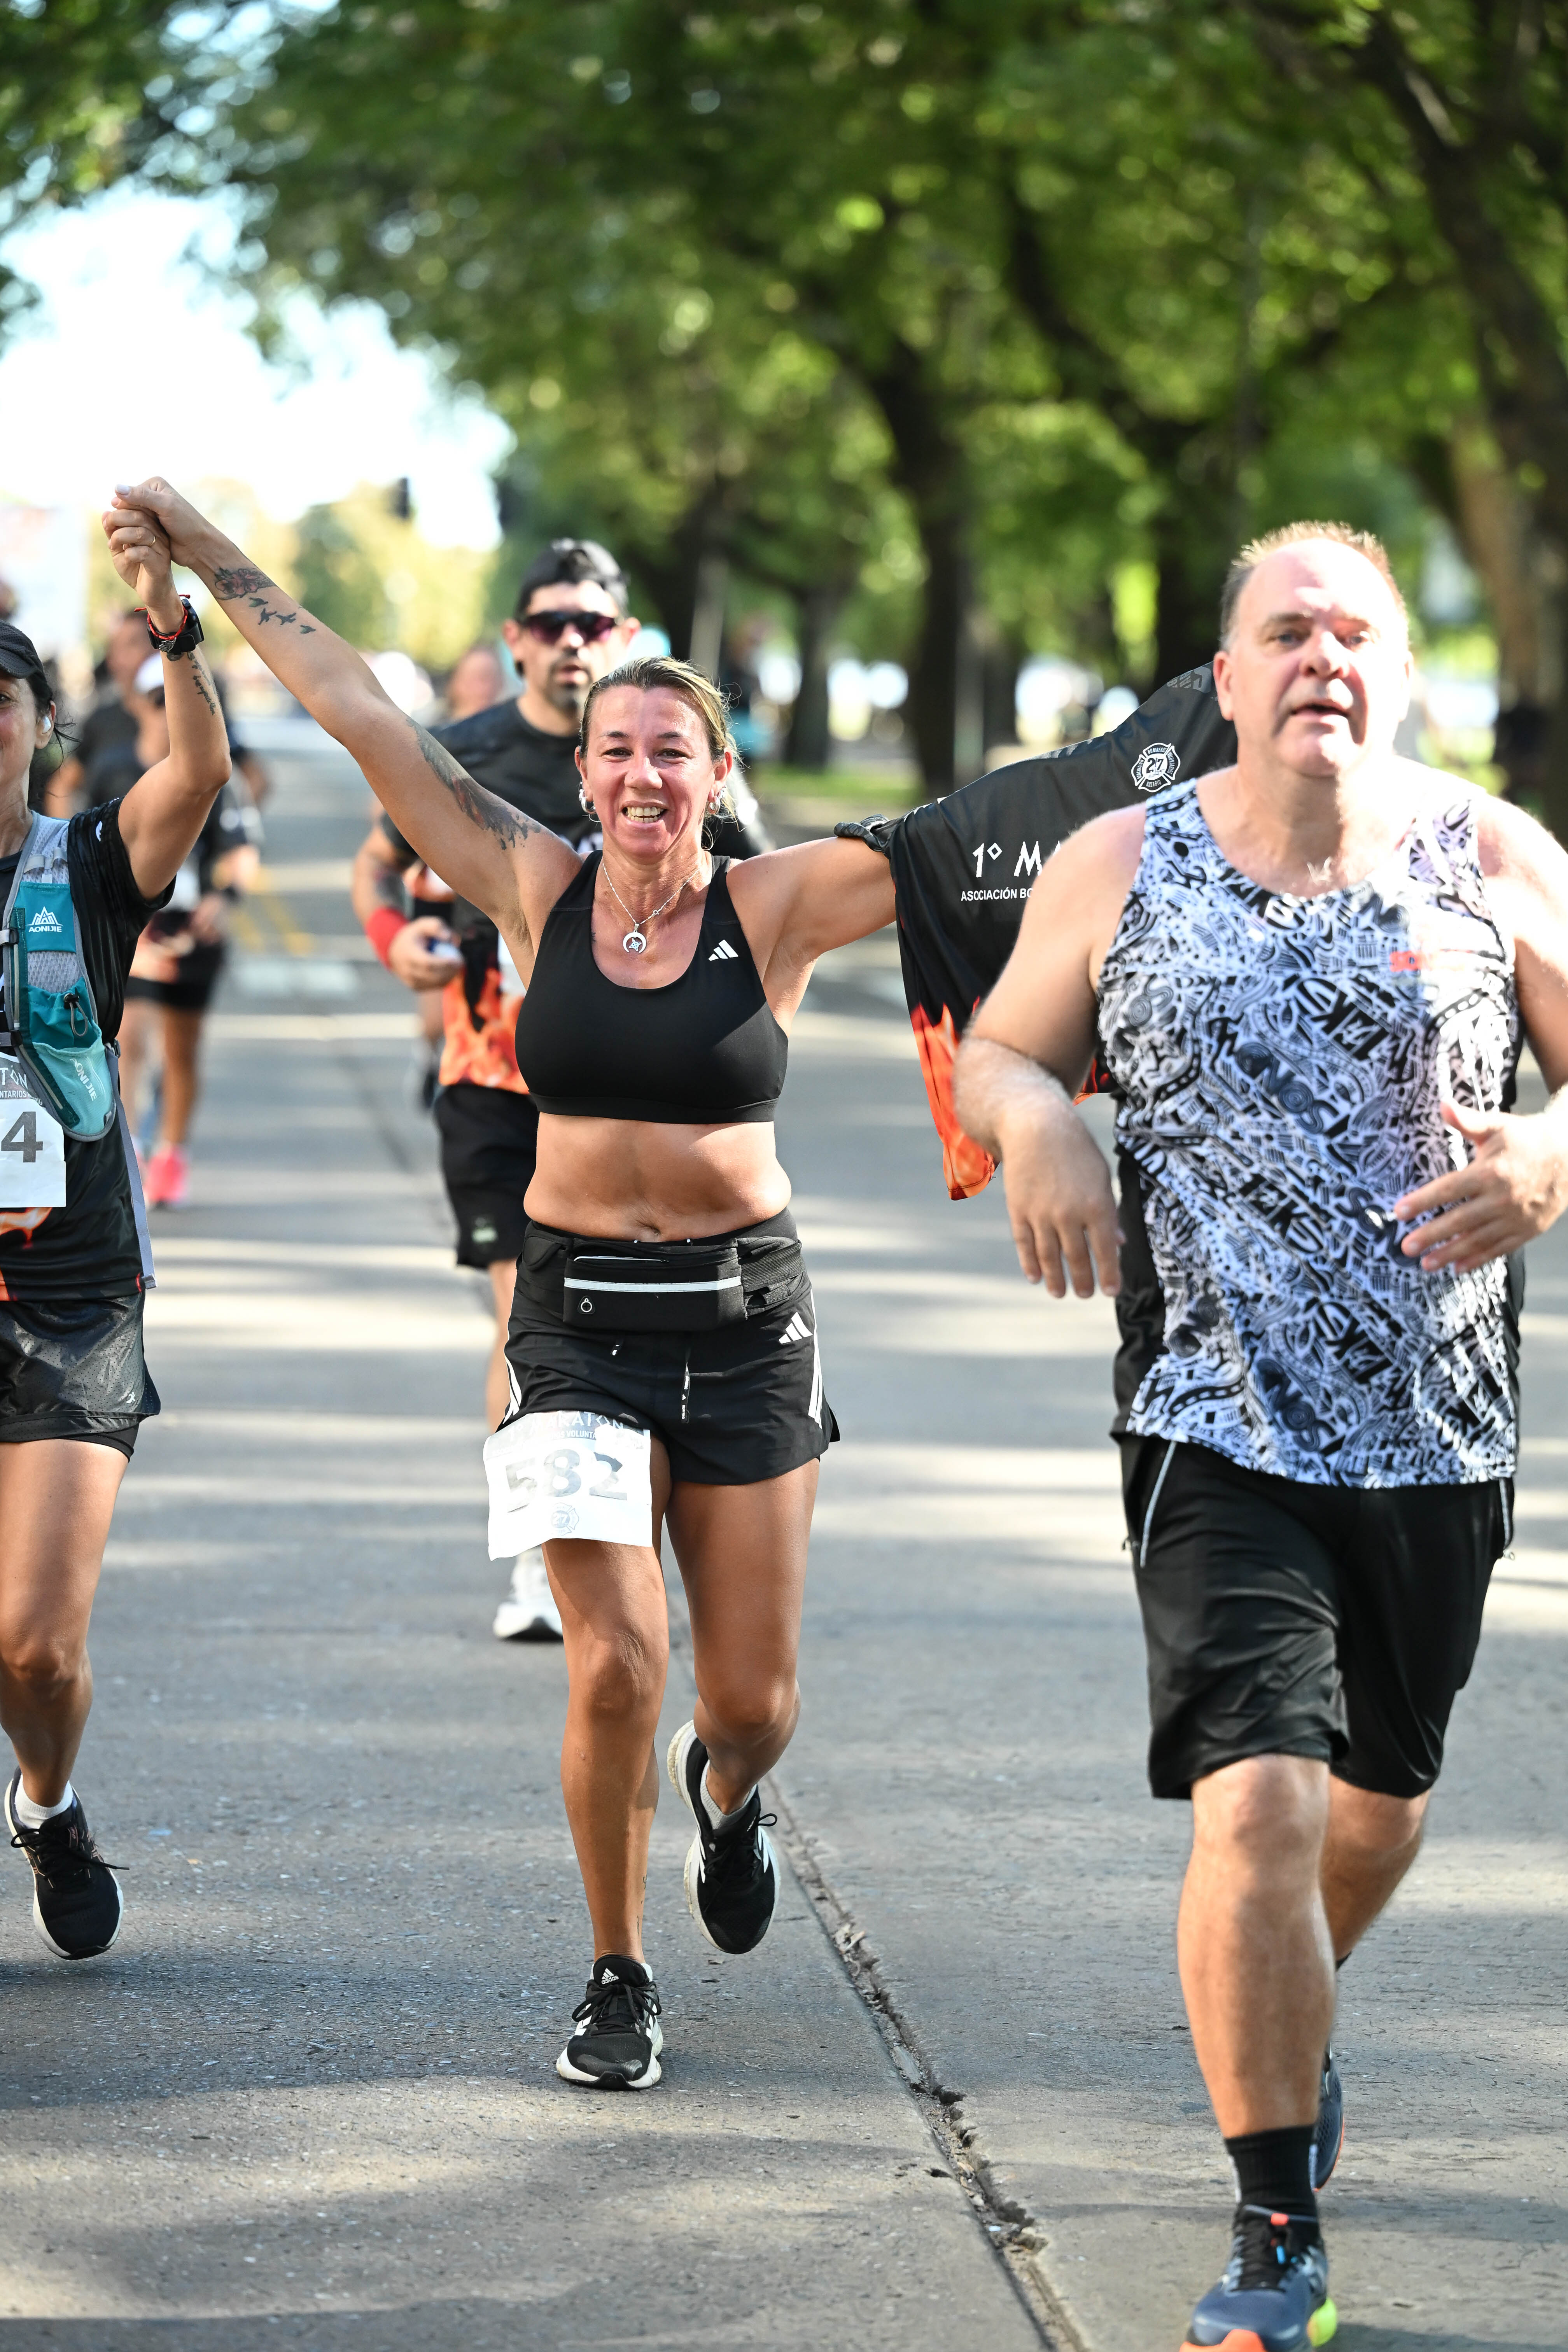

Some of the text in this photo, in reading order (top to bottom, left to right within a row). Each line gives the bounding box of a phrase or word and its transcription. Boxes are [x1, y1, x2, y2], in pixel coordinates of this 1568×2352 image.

[1146, 758, 1164, 774] 27
[961, 887, 1017, 901] ASOCIACIÓN
[1, 1111, 43, 1163] 4
[505, 1449, 628, 1513] 582
[601, 1975, 619, 1984] adidas
